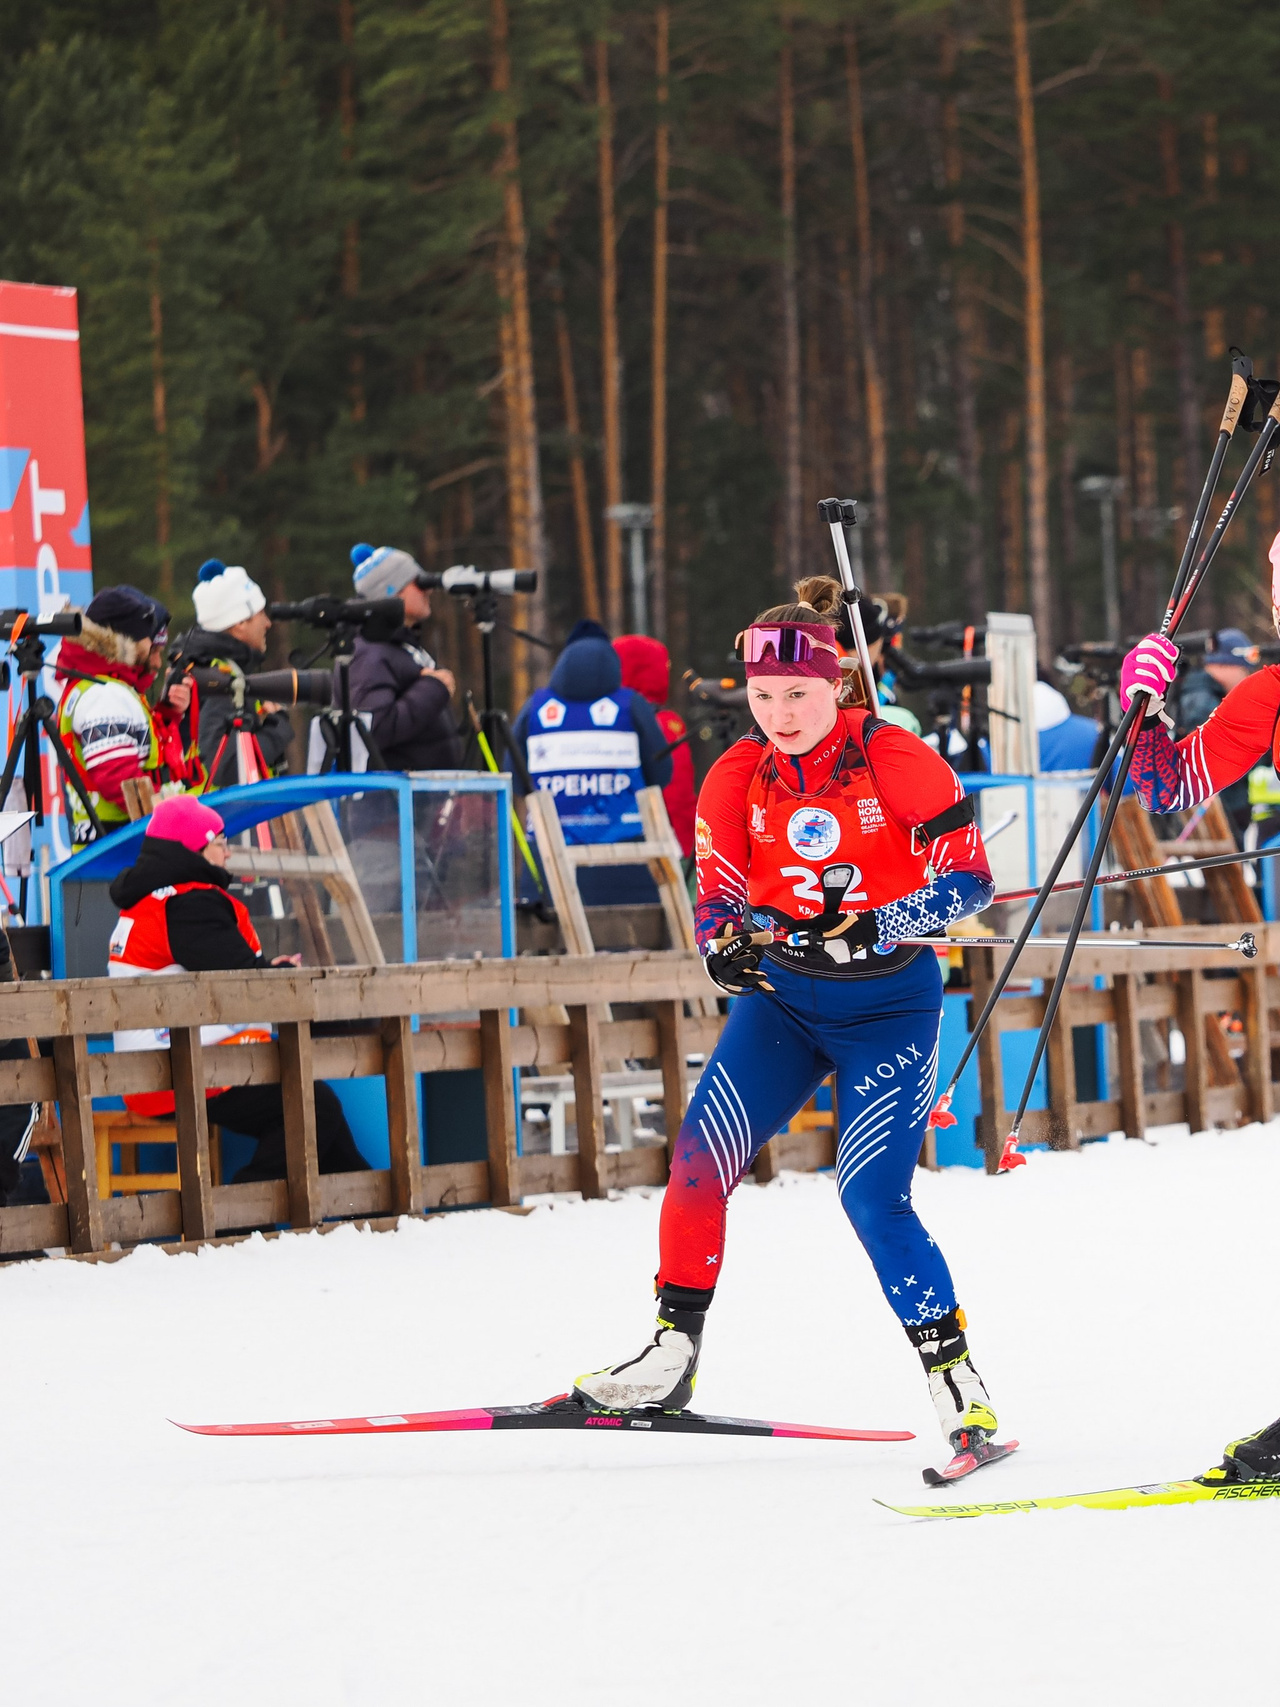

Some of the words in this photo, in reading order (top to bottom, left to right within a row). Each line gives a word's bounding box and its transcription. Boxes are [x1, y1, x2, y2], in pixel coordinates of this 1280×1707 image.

[1215, 500, 1234, 530] MOAX
[537, 773, 631, 797] ТРЕНЕР
[856, 797, 880, 808] СПОР
[853, 1042, 923, 1097] MOAX
[918, 1327, 939, 1341] 172
[585, 1416, 624, 1427] ATOMIC
[926, 1500, 1039, 1514] FISCHER
